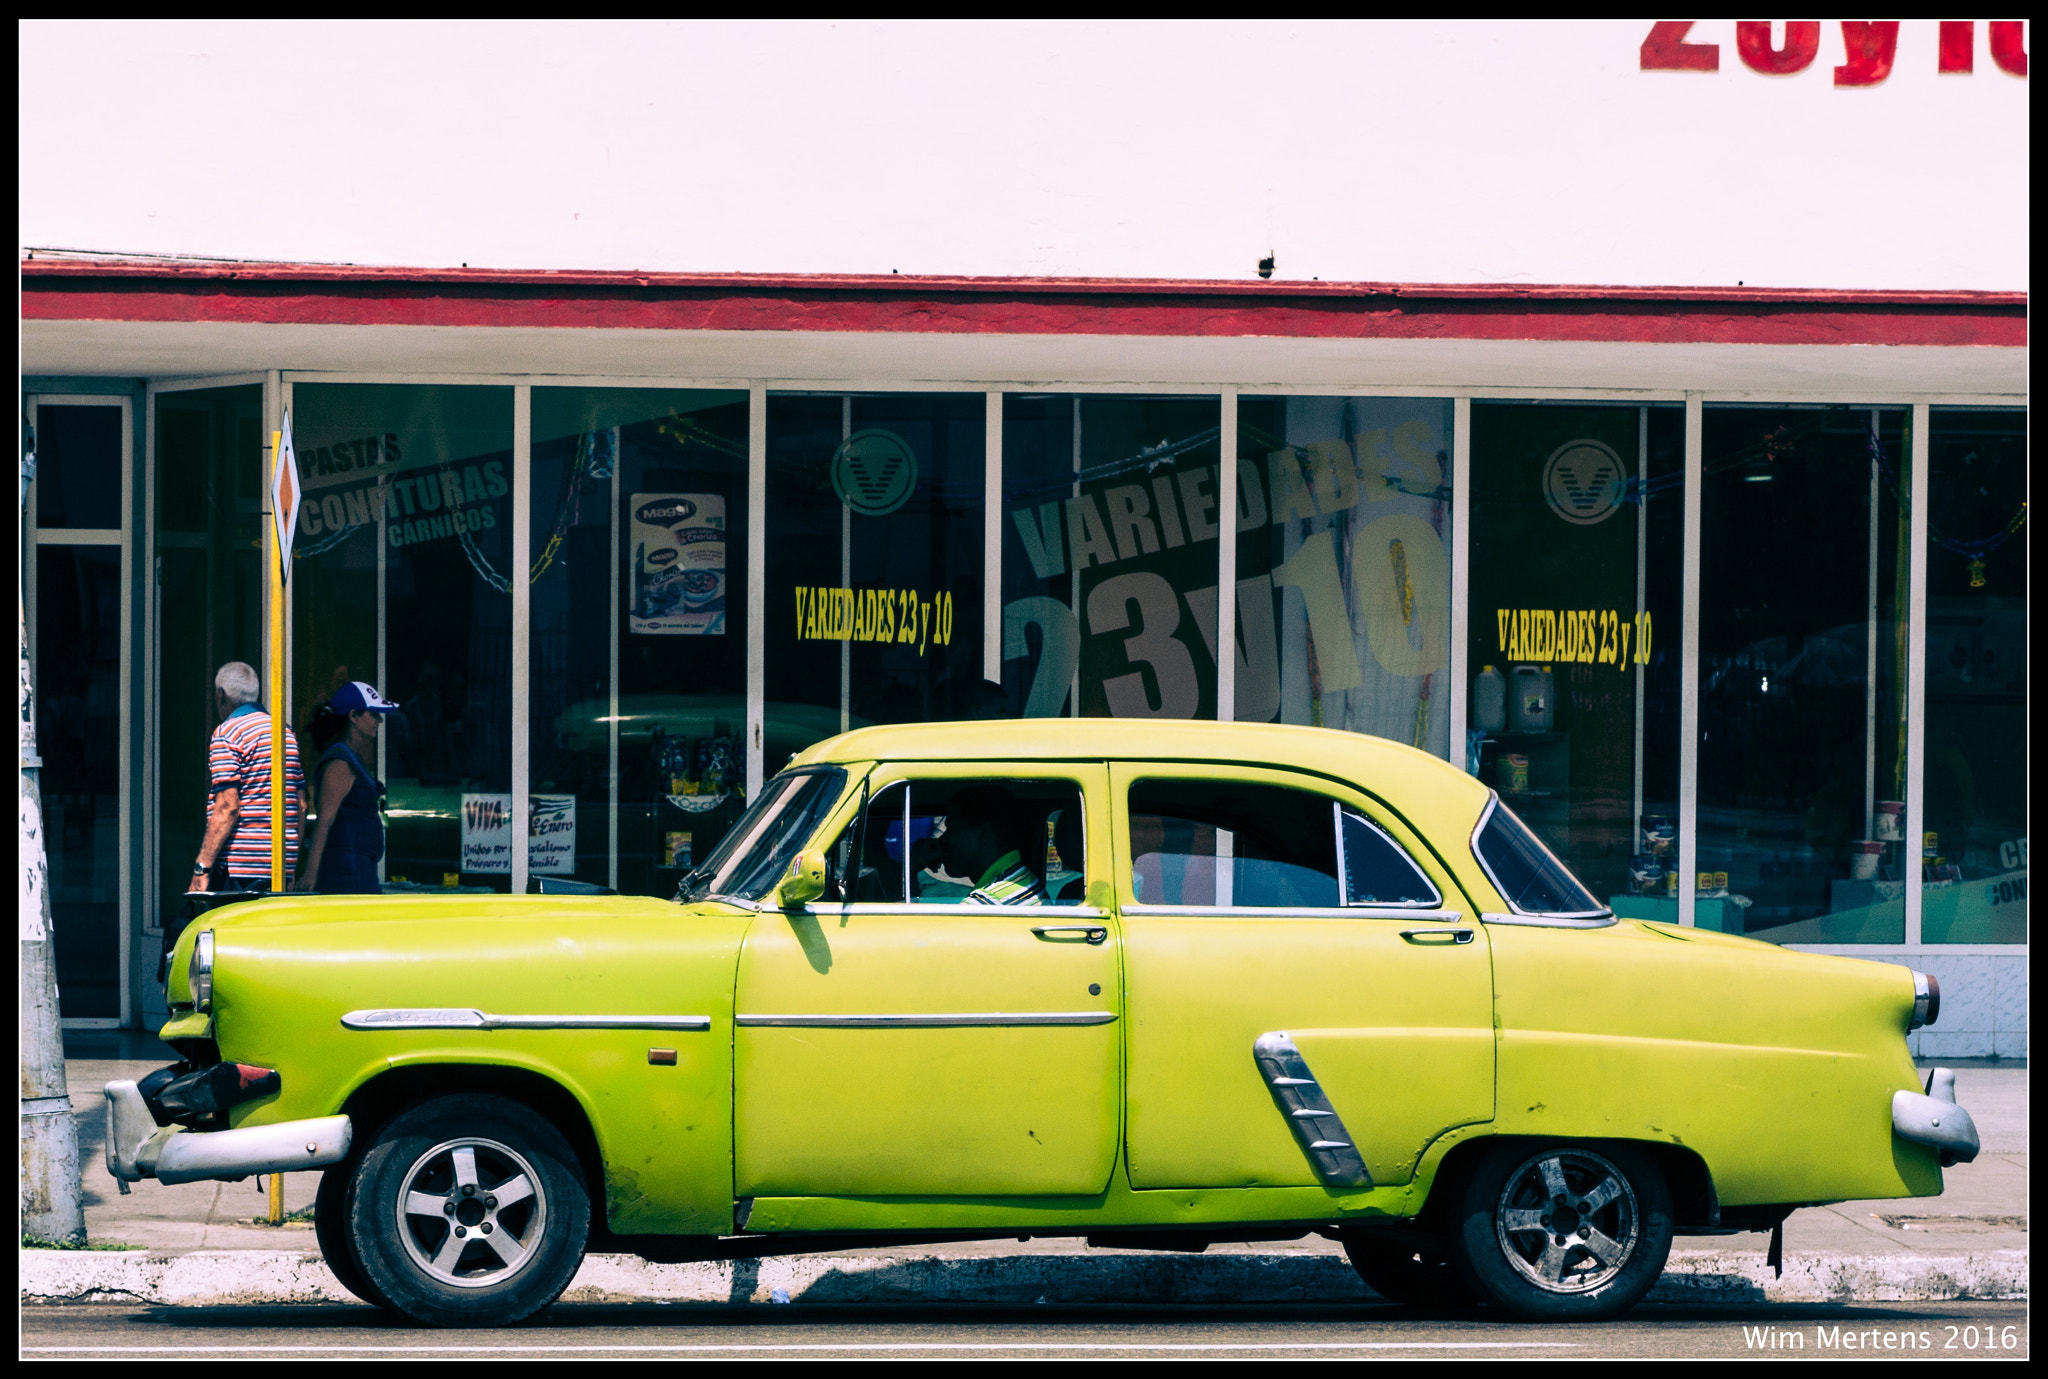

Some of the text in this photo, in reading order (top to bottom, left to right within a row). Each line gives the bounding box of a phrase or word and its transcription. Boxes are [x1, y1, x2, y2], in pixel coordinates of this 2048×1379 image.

[299, 433, 402, 479] PASTAS
[300, 461, 509, 536] CONFITURAS
[1012, 421, 1442, 580] VARIEDADES
[795, 586, 952, 657] VARIEDADES 23 y 10
[1497, 608, 1652, 672] VARIEDADES 23 y 10
[528, 840, 571, 854] ocialismo
